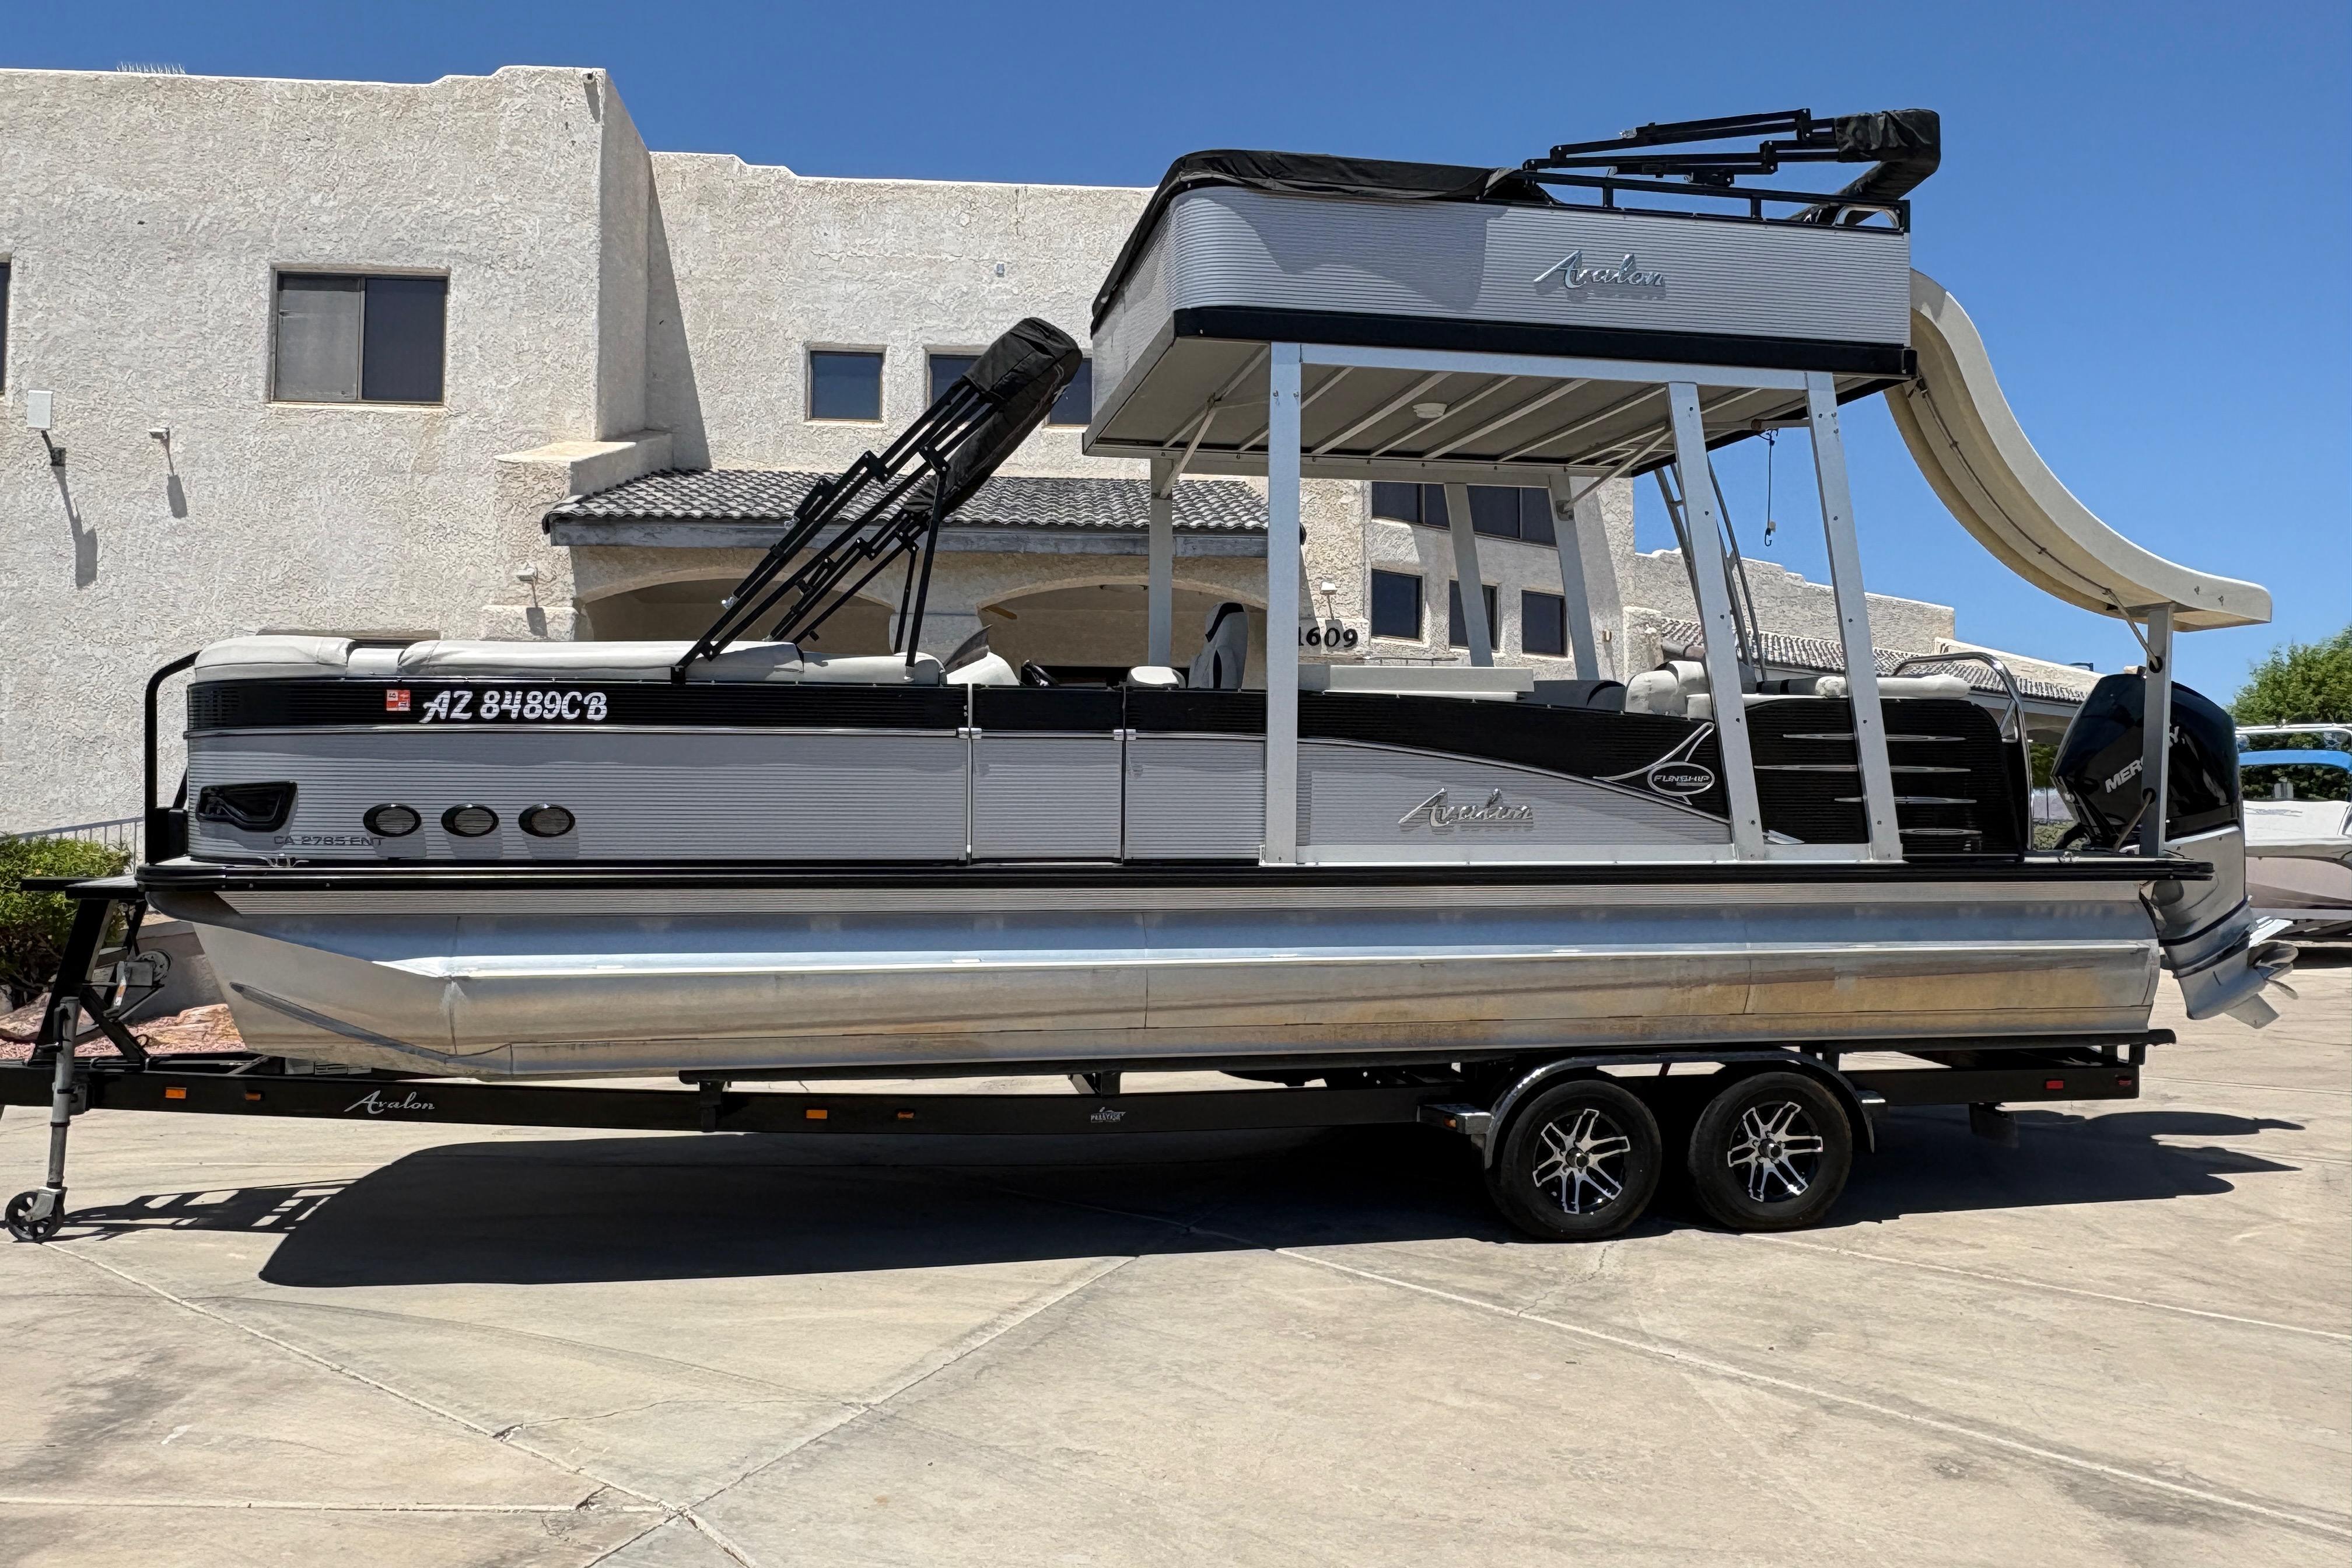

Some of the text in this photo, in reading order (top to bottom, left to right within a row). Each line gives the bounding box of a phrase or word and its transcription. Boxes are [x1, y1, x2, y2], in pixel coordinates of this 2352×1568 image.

[1534, 250, 1663, 289] Avalon
[419, 691, 473, 723] AZ
[480, 691, 607, 720] 8489CB
[1398, 788, 1533, 827] Avalon
[344, 1090, 435, 1115] Avalon
